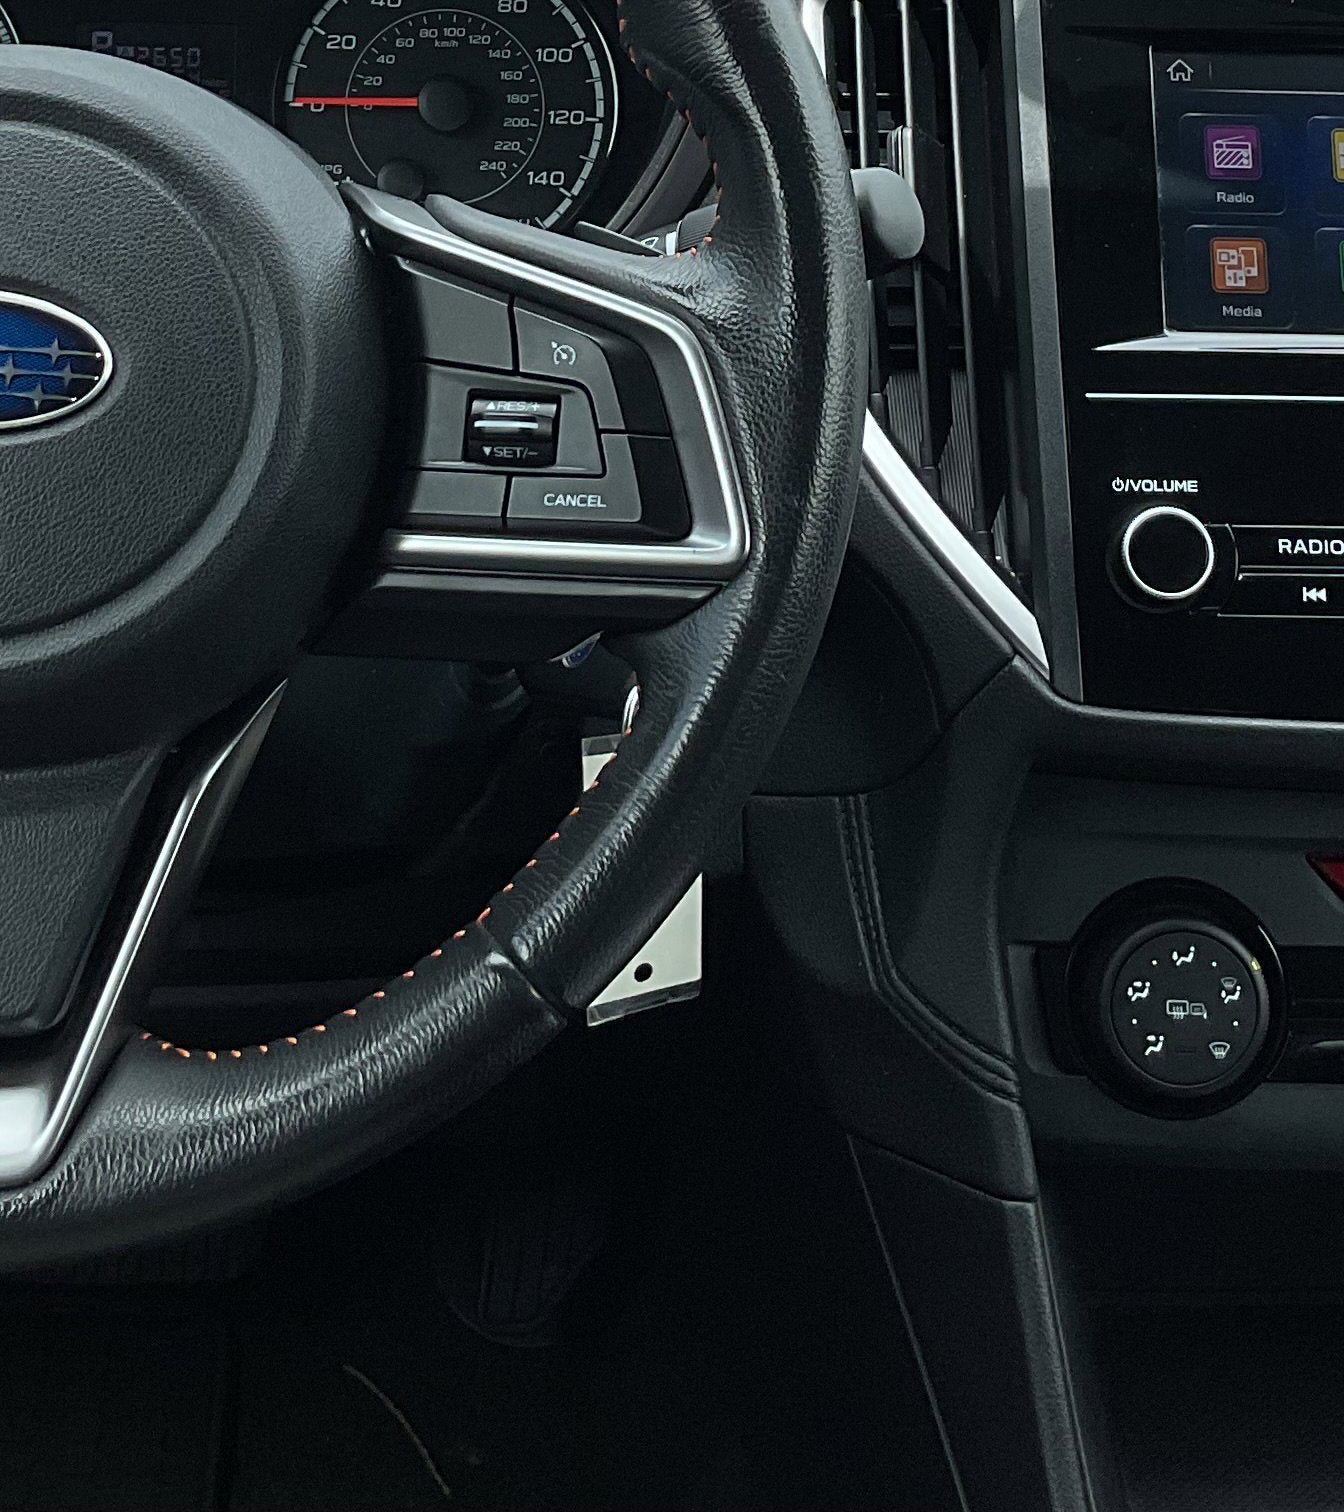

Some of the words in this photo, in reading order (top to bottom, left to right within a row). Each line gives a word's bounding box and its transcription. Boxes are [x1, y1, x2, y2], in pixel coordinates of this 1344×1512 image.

[419, 28, 438, 38] 80
[443, 27, 466, 37] 100
[326, 35, 357, 50] 20
[395, 38, 415, 48] 60
[468, 35, 491, 45] 120
[376, 54, 396, 64] 40
[488, 49, 511, 59] 140
[535, 47, 573, 63] 100
[500, 70, 523, 80] 160
[363, 76, 383, 86] 20
[507, 94, 530, 104] 180
[503, 117, 530, 128] 200
[548, 110, 585, 125] 120
[494, 141, 521, 151] 220
[479, 160, 506, 171] 240
[526, 170, 565, 186] 140
[1216, 191, 1255, 205] Radio
[1222, 305, 1263, 318] Media
[543, 493, 607, 508] CANCEL
